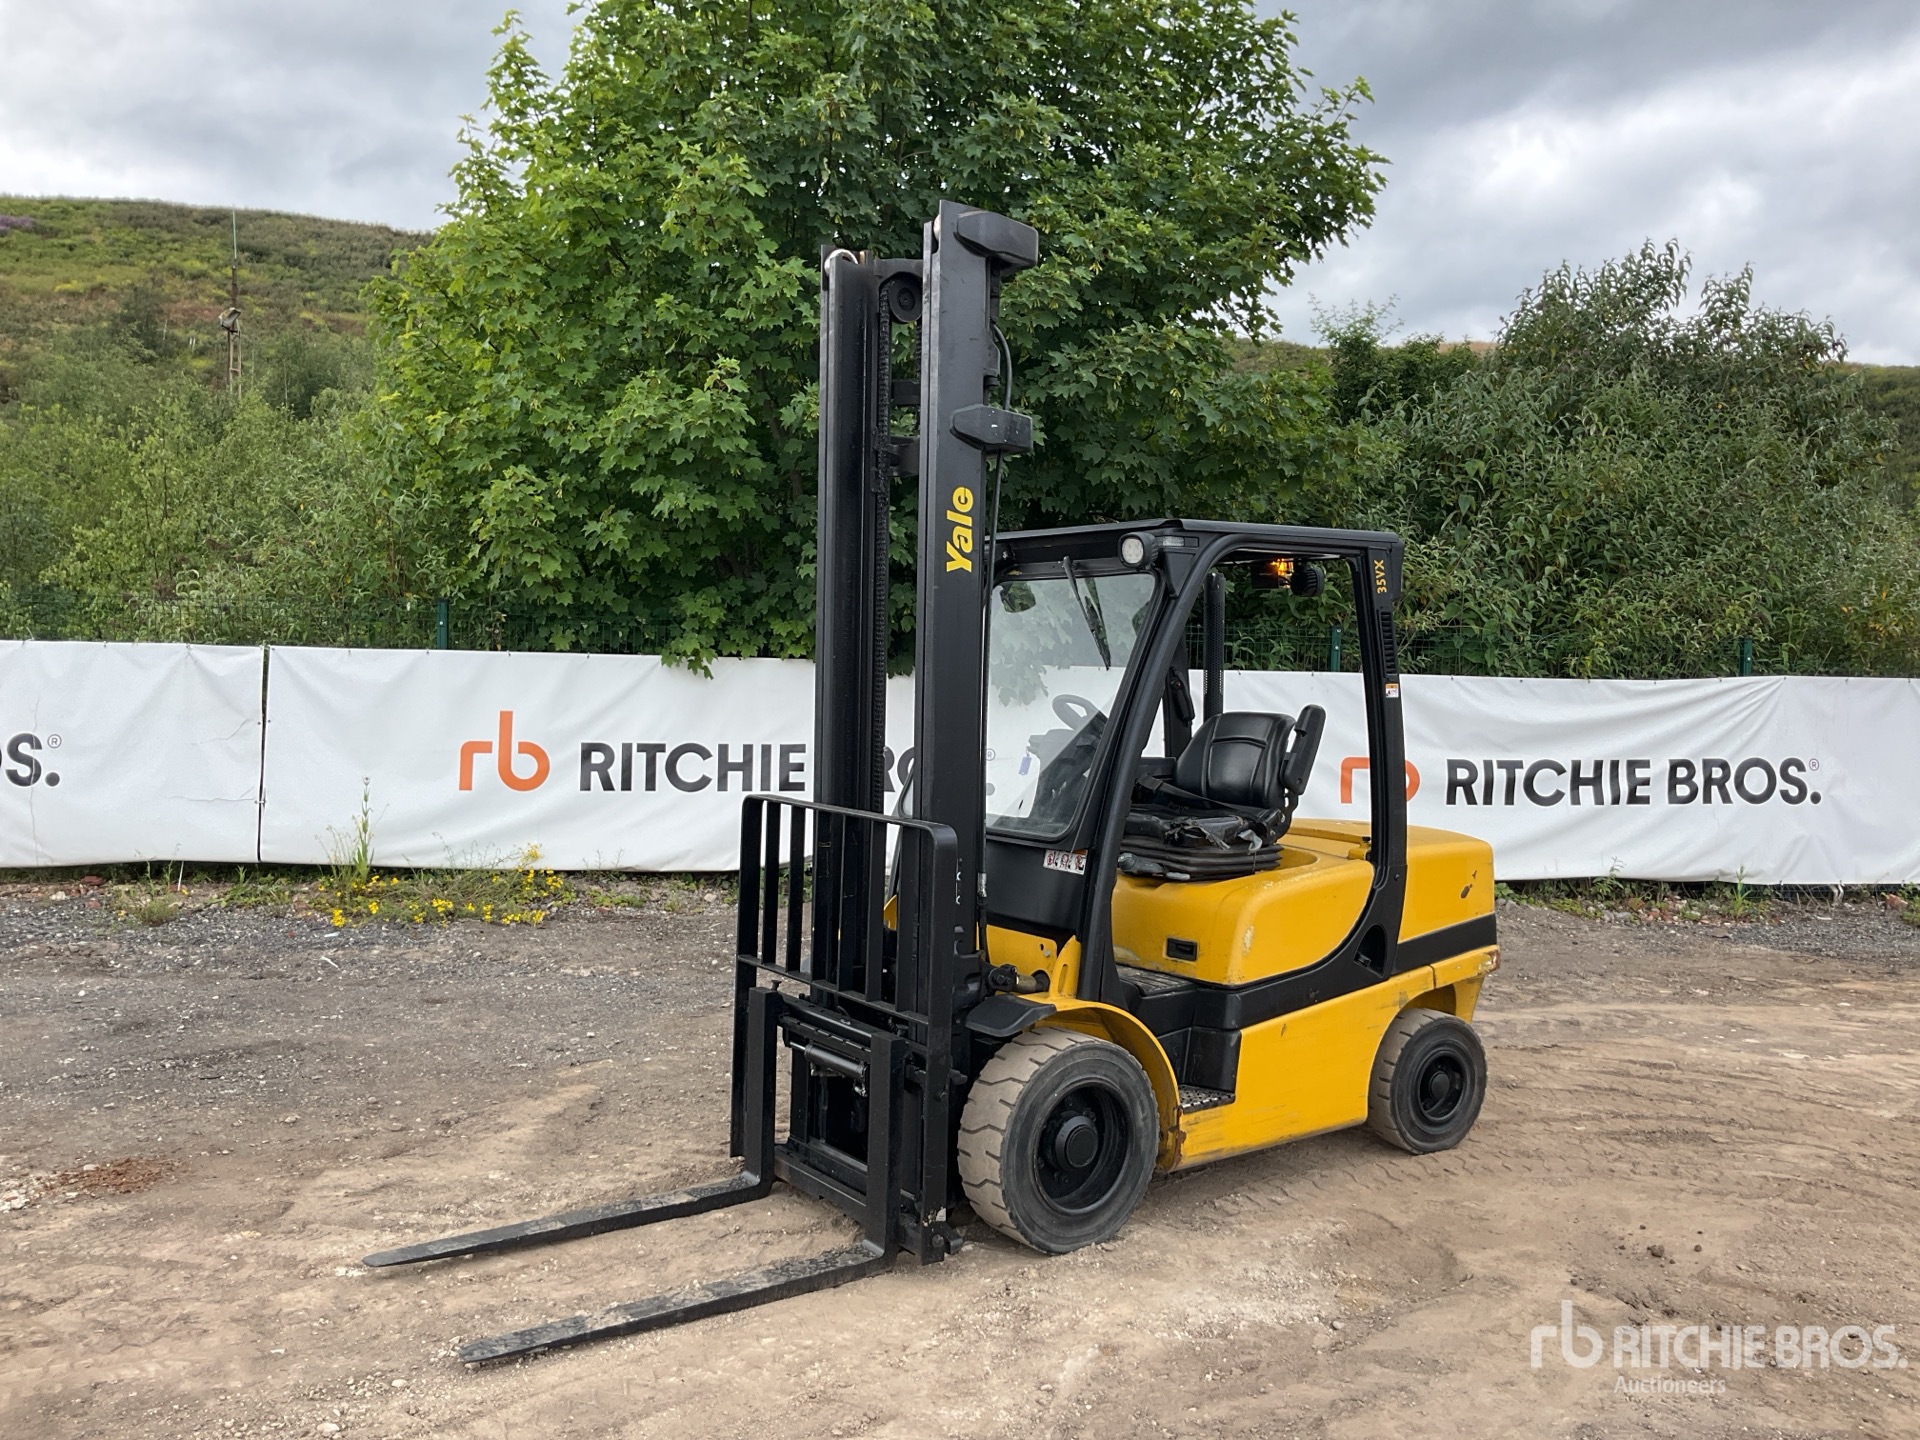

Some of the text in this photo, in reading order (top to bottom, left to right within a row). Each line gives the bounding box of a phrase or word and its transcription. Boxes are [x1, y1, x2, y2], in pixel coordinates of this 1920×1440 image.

[946, 486, 974, 573] Yale
[1373, 559, 1388, 594] 35VX
[459, 711, 549, 791] rb
[579, 742, 807, 792] RITCHIE
[1446, 758, 1651, 806] RITCHIE
